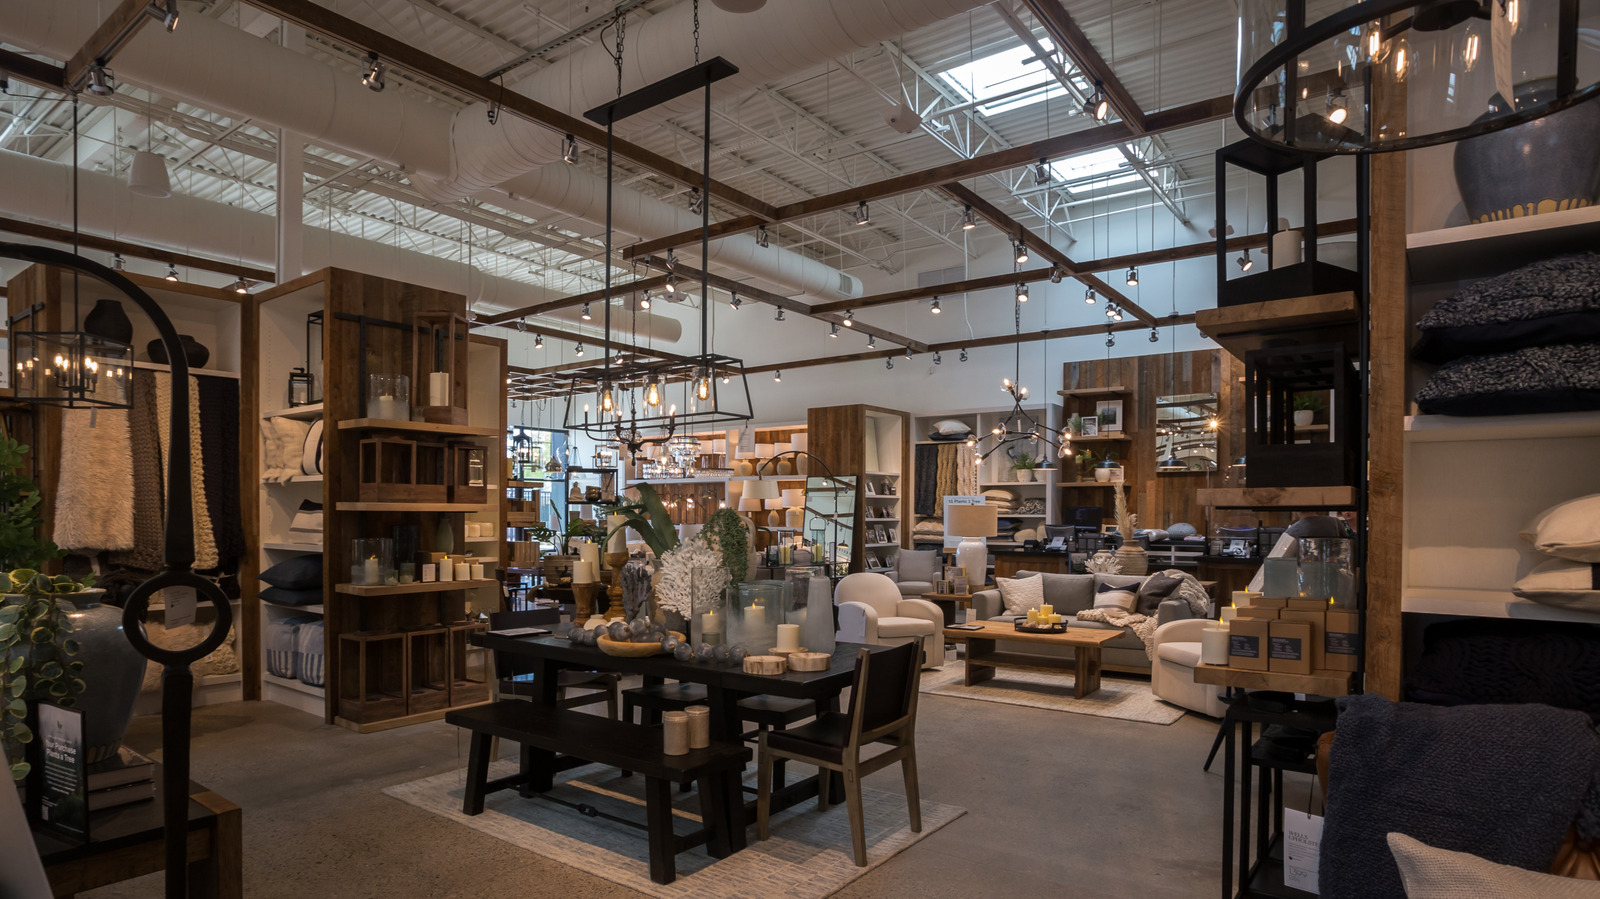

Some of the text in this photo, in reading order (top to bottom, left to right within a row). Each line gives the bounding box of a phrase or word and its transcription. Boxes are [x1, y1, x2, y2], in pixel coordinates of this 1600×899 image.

[55, 742, 76, 755] Purchase
[46, 748, 60, 759] Plants
[64, 754, 75, 764] Tree
[1288, 830, 1308, 839] WELLS
